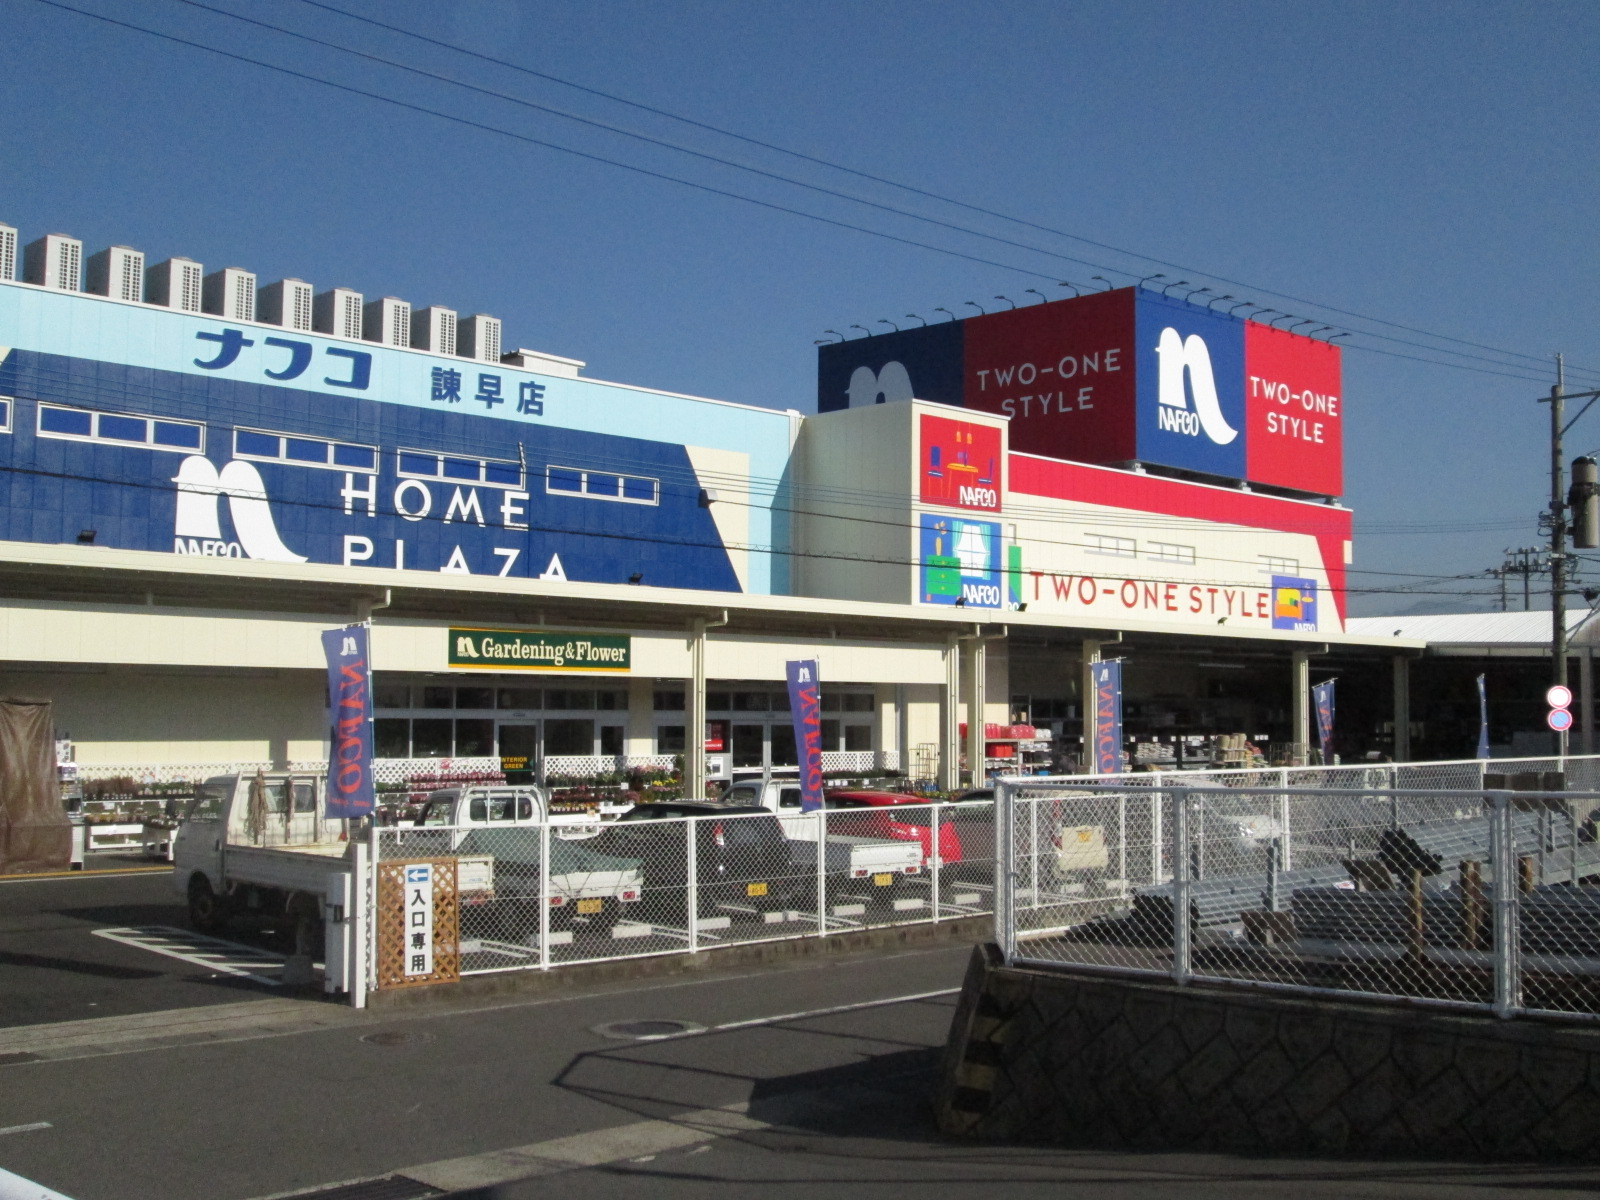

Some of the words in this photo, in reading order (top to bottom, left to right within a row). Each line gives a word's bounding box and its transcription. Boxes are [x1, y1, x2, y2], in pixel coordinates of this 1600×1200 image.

[193, 328, 373, 391] ナフコ
[430, 366, 546, 417] 諫早店
[976, 348, 1121, 391] TWO-ONE
[1001, 386, 1094, 418] STYLE
[1249, 376, 1338, 417] TWO-ONE
[1158, 405, 1200, 437] NAFCO
[1267, 412, 1324, 444] STYLE
[340, 472, 530, 532] HOME
[959, 485, 997, 508] NAFCO
[963, 583, 1000, 606] NAFCO
[1029, 570, 1179, 612] TWO-ONE
[1189, 585, 1270, 619] STYLE
[410, 889, 427, 973] 入口専用
